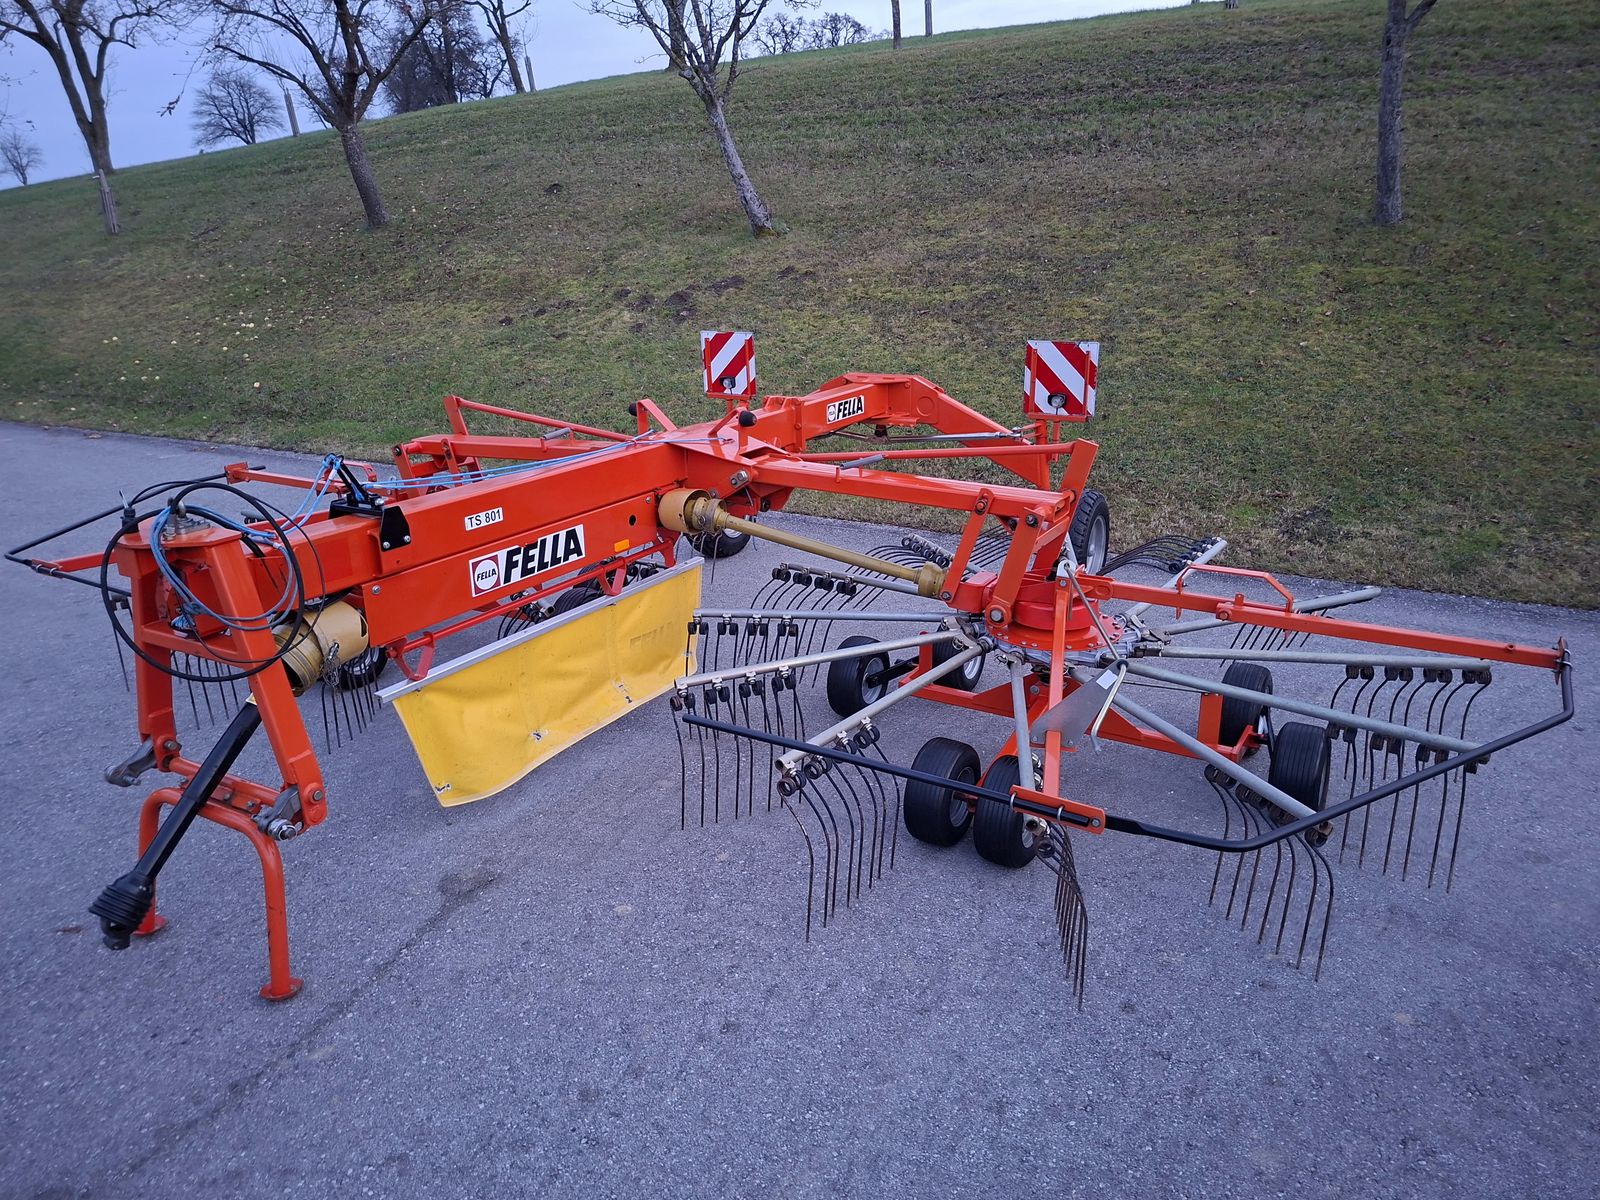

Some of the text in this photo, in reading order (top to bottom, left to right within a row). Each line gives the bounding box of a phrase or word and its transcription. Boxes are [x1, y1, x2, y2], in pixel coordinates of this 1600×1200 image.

[836, 397, 863, 420] FELLA
[467, 509, 502, 527] TS 801
[503, 527, 583, 585] FELLA
[476, 569, 497, 582] FELLA
